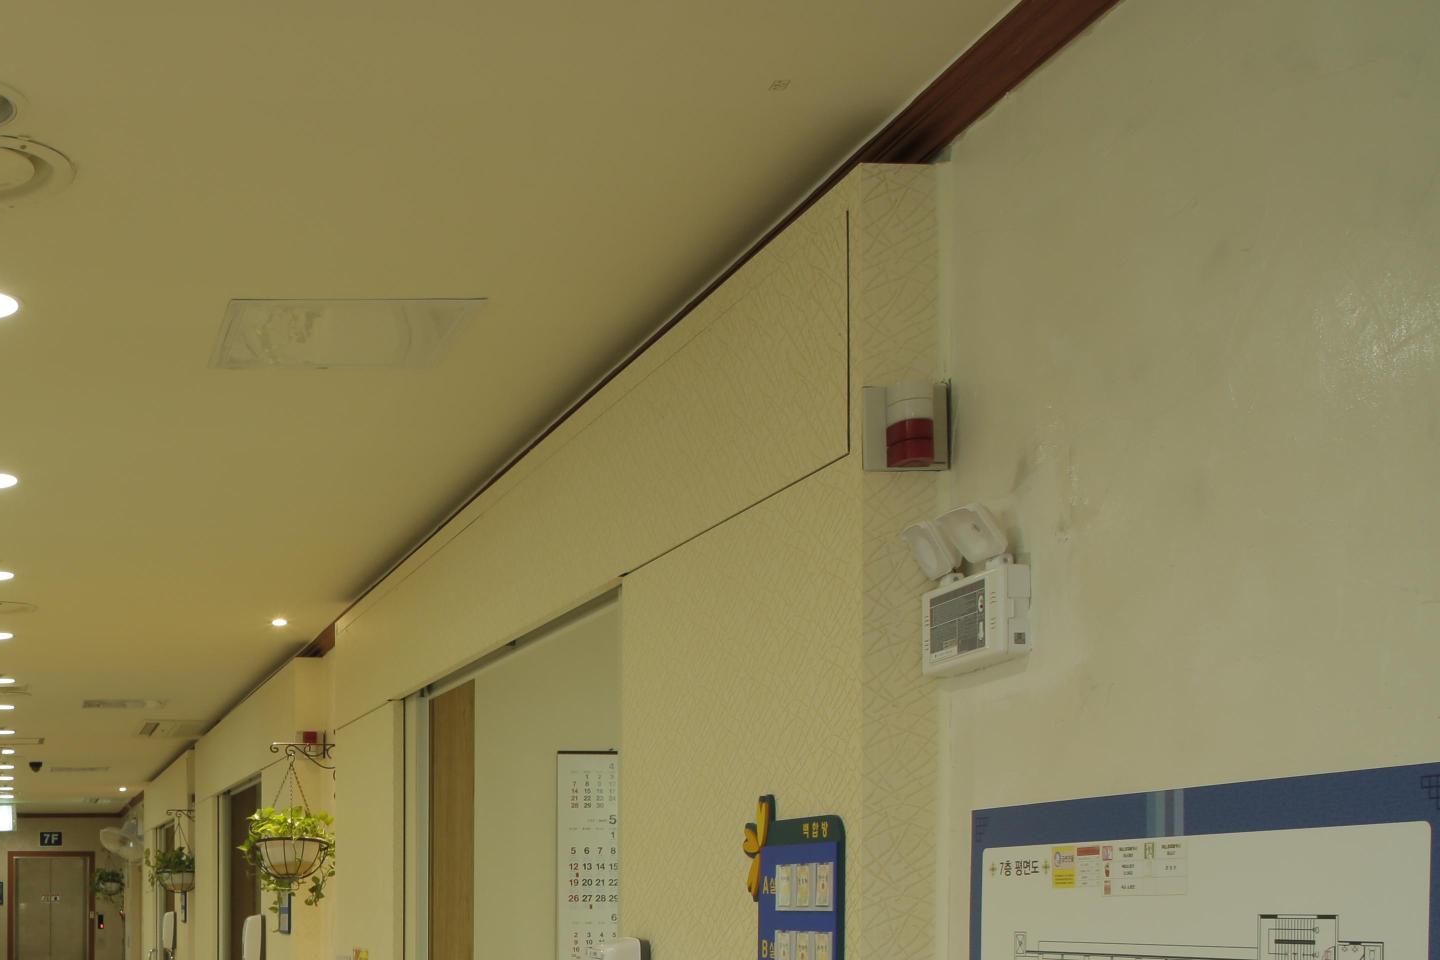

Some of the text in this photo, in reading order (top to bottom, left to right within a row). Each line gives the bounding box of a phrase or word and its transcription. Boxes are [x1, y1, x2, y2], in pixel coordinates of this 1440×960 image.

[609, 815, 617, 825] 5
[43, 833, 59, 844] 7F
[999, 860, 1013, 876] 7층
[1014, 859, 1040, 876] 평면도
